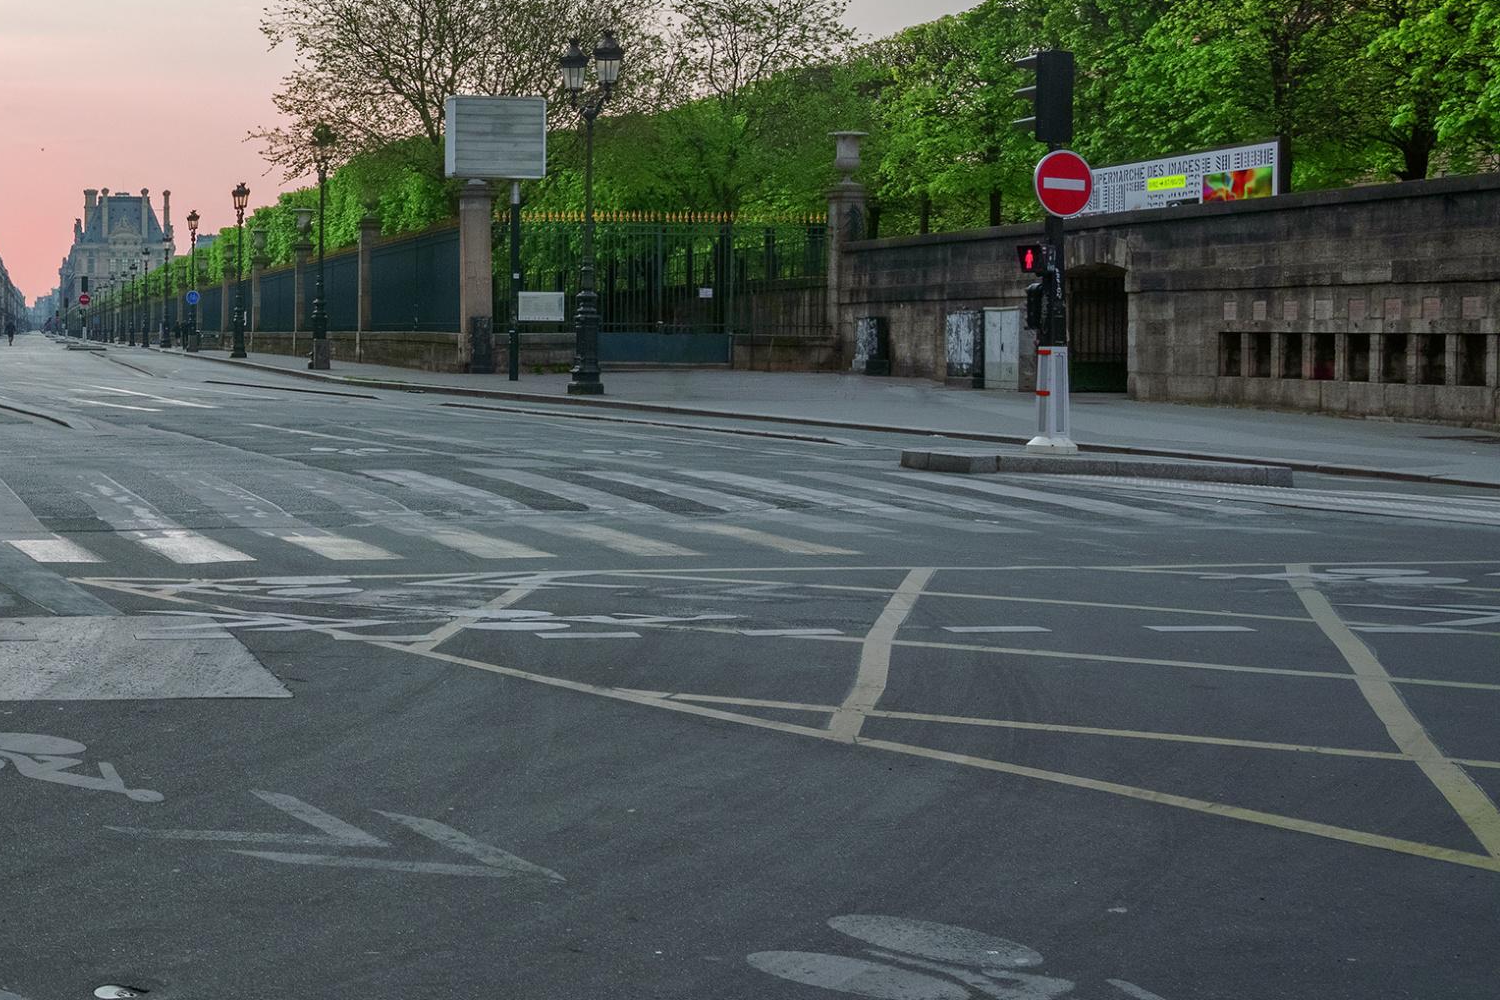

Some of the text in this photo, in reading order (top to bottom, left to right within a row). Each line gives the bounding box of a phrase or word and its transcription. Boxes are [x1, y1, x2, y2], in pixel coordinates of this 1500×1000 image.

[1092, 164, 1145, 185] UPERMARCHÉ
[1147, 163, 1164, 178] DES
[1168, 159, 1200, 175] IMAGES
